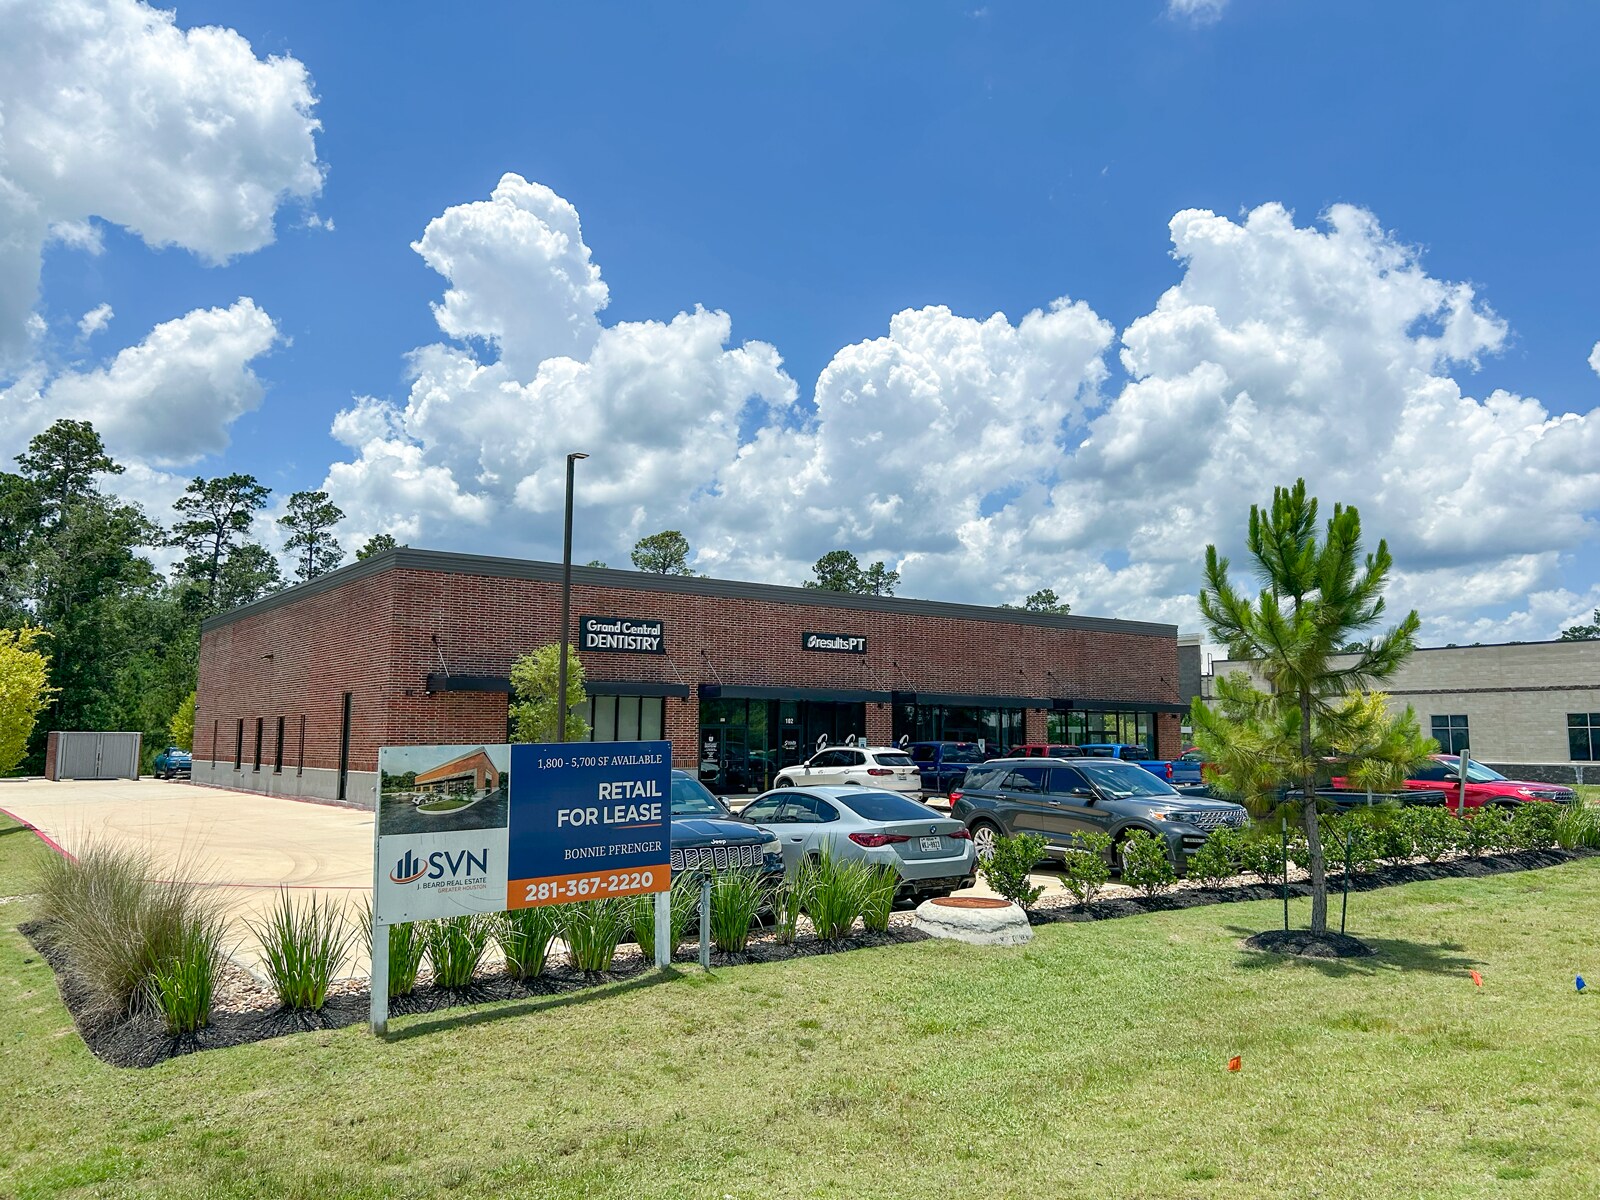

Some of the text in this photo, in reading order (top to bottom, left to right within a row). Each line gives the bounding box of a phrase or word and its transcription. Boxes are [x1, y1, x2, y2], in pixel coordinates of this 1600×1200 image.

[586, 619, 660, 635] Grand Central
[586, 633, 660, 651] DENTISTRY
[537, 758, 564, 770] 1,800
[571, 757, 596, 769] 5,700
[597, 756, 609, 766] SF
[611, 754, 663, 766] AVAILABLE
[599, 780, 662, 800] RETAIL
[557, 803, 662, 828] FOR LEASE
[564, 840, 662, 860] BONNIE PFRENGER
[427, 848, 487, 879] SVN
[423, 881, 446, 889] BEARD
[465, 877, 487, 885] ESTATE
[437, 886, 462, 894] GREATER
[525, 871, 653, 902] 281-367-2220
